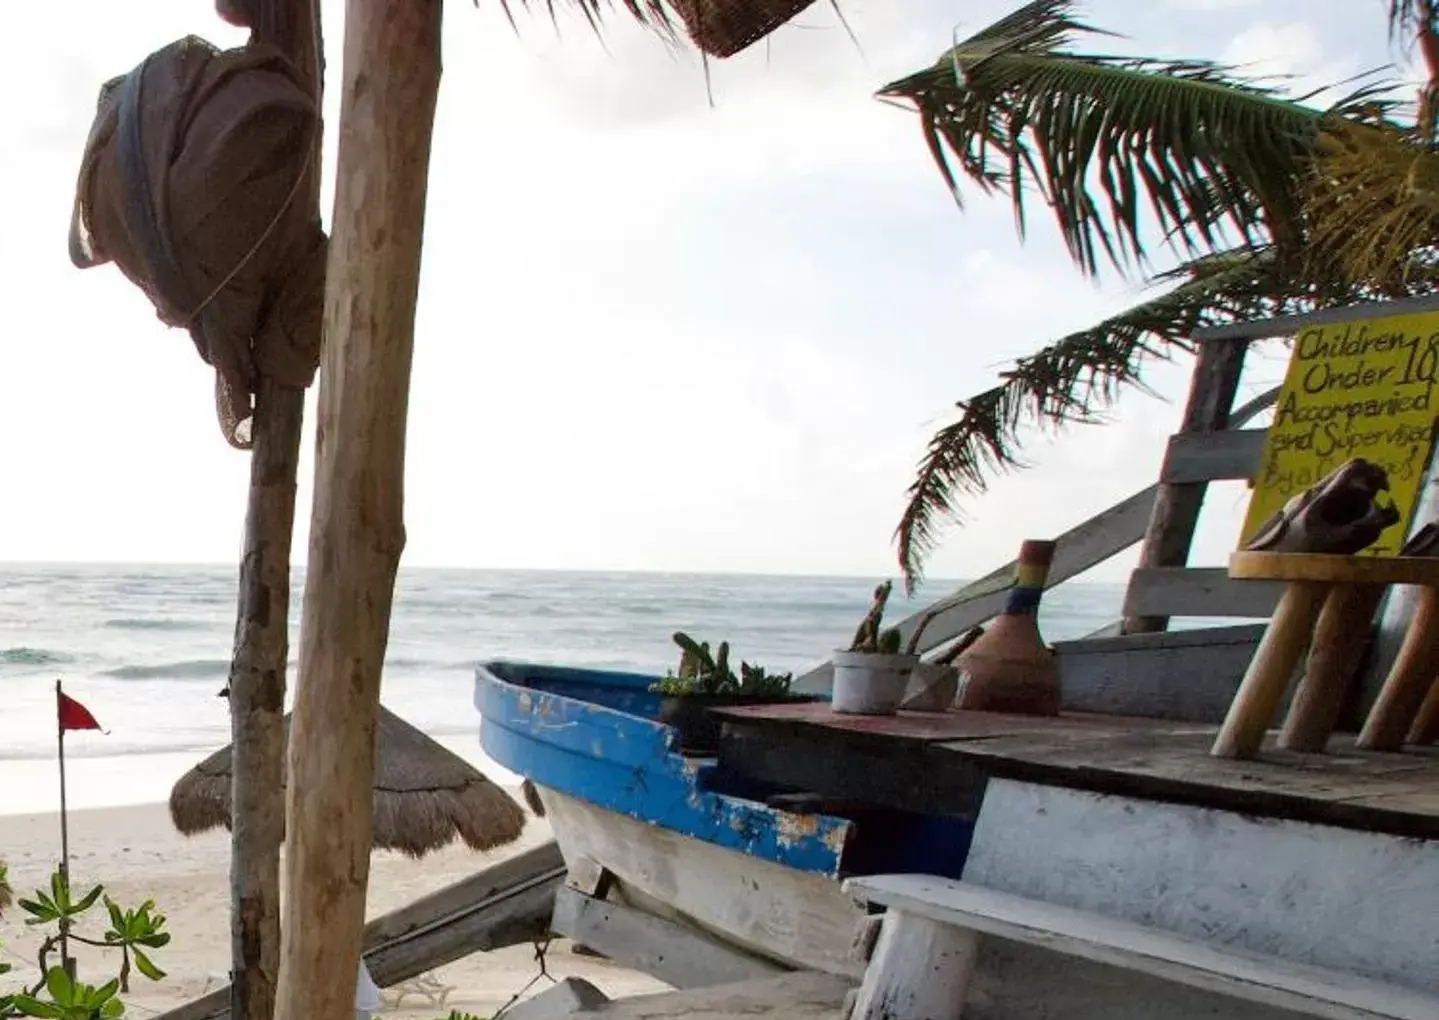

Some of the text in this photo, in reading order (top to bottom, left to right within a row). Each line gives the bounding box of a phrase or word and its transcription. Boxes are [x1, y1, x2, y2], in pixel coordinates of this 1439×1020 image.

[1299, 322, 1404, 361] Children
[1276, 386, 1430, 433] Accompanied
[1272, 422, 1320, 449] and
